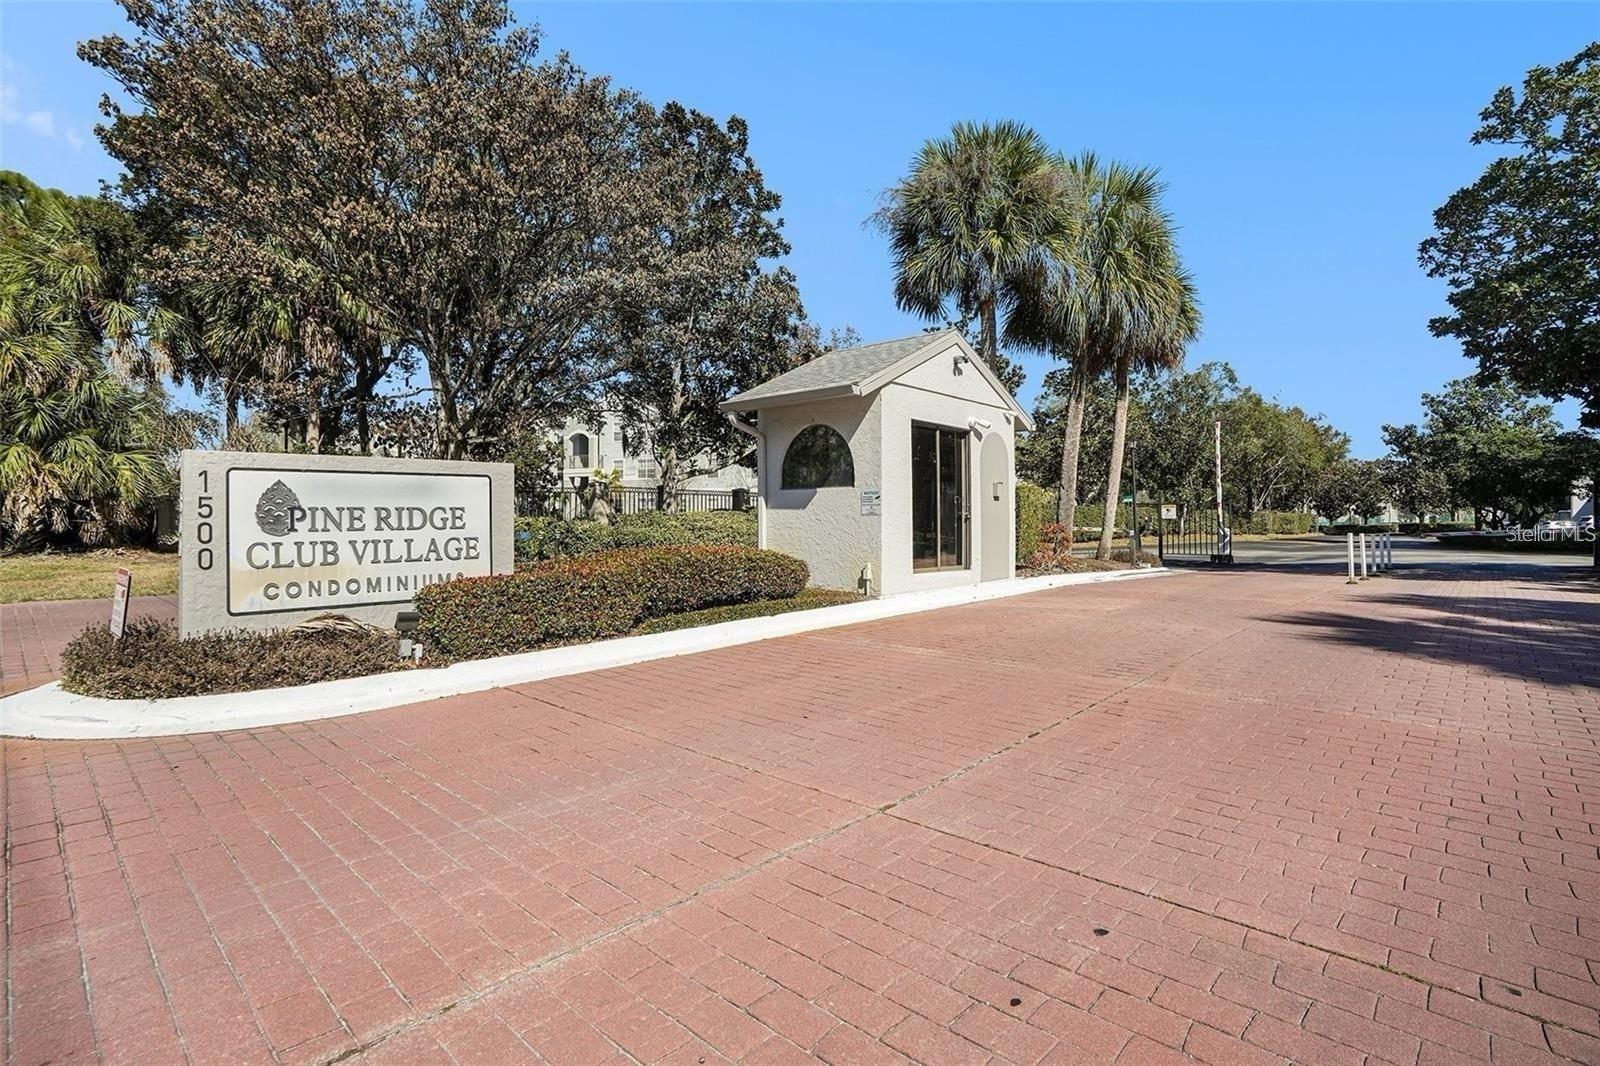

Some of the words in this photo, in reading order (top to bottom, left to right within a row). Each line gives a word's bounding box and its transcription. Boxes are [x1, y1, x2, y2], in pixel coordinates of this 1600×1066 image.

[198, 470, 214, 571] 1500
[287, 505, 366, 533] PINE
[374, 506, 466, 531] RIDGE
[246, 540, 341, 569] CLUB
[349, 536, 481, 565] VILLAGE
